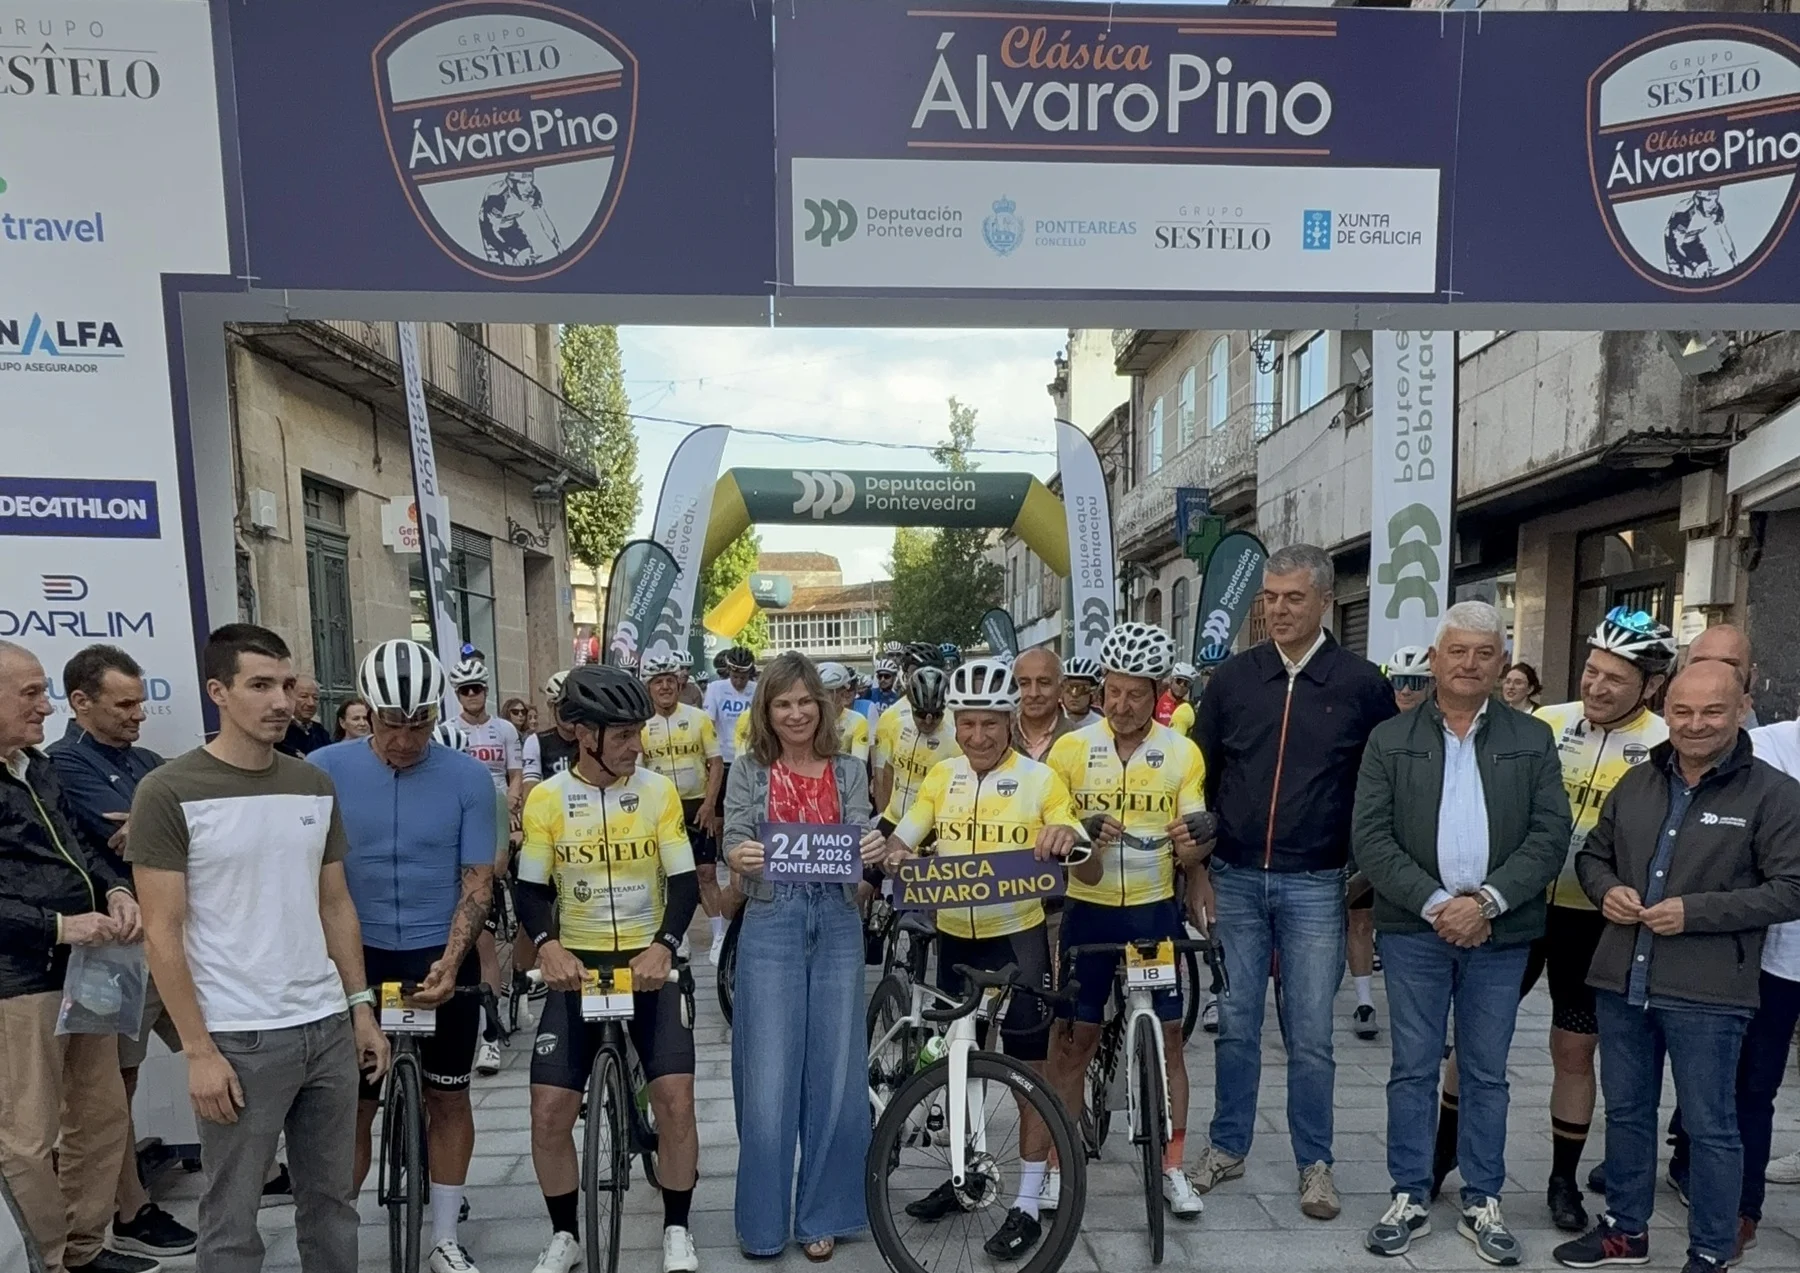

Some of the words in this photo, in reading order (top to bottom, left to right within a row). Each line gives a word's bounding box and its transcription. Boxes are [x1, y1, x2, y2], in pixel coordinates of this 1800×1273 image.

[0, 18, 104, 38] RUPO
[457, 26, 526, 47] GRUPO
[1001, 25, 1153, 71] Clásica
[1669, 51, 1734, 71] GRUPO
[445, 106, 522, 132] Clásica
[1645, 128, 1717, 153] Clásica
[866, 205, 963, 225] Deputación
[1178, 205, 1244, 218] GRUPO
[1337, 213, 1390, 228] XUNTA
[1, 211, 104, 242] travel
[866, 223, 963, 239] Pontevedra
[1035, 219, 1138, 235] PONTEAREAS
[1035, 236, 1087, 247] CONCELLO
[1337, 231, 1355, 244] DE
[1359, 231, 1422, 245] GALICIA
[24, 363, 98, 373] ASEGURADOR
[865, 476, 977, 496] Deputación
[0, 496, 148, 520] DECATHLON
[865, 494, 977, 511] Pontevedra
[625, 557, 657, 617] Deputación
[1220, 548, 1252, 606] Deputación
[1228, 552, 1260, 611] Pontevedra
[634, 562, 666, 622] Pontevedra
[0, 611, 154, 638] DARLIM
[575, 827, 630, 837] GRUPO
[935, 817, 1028, 845] ESTELO
[771, 833, 810, 860] 24
[812, 834, 853, 847] MAIO
[817, 849, 852, 862] 2026
[769, 861, 852, 875] PONTEAREAS
[900, 859, 995, 883] CLÁSICA
[903, 883, 991, 904] ÁLVARO
[998, 873, 1056, 897] PINO
[1143, 968, 1159, 980] 18
[402, 1010, 415, 1024] 2
